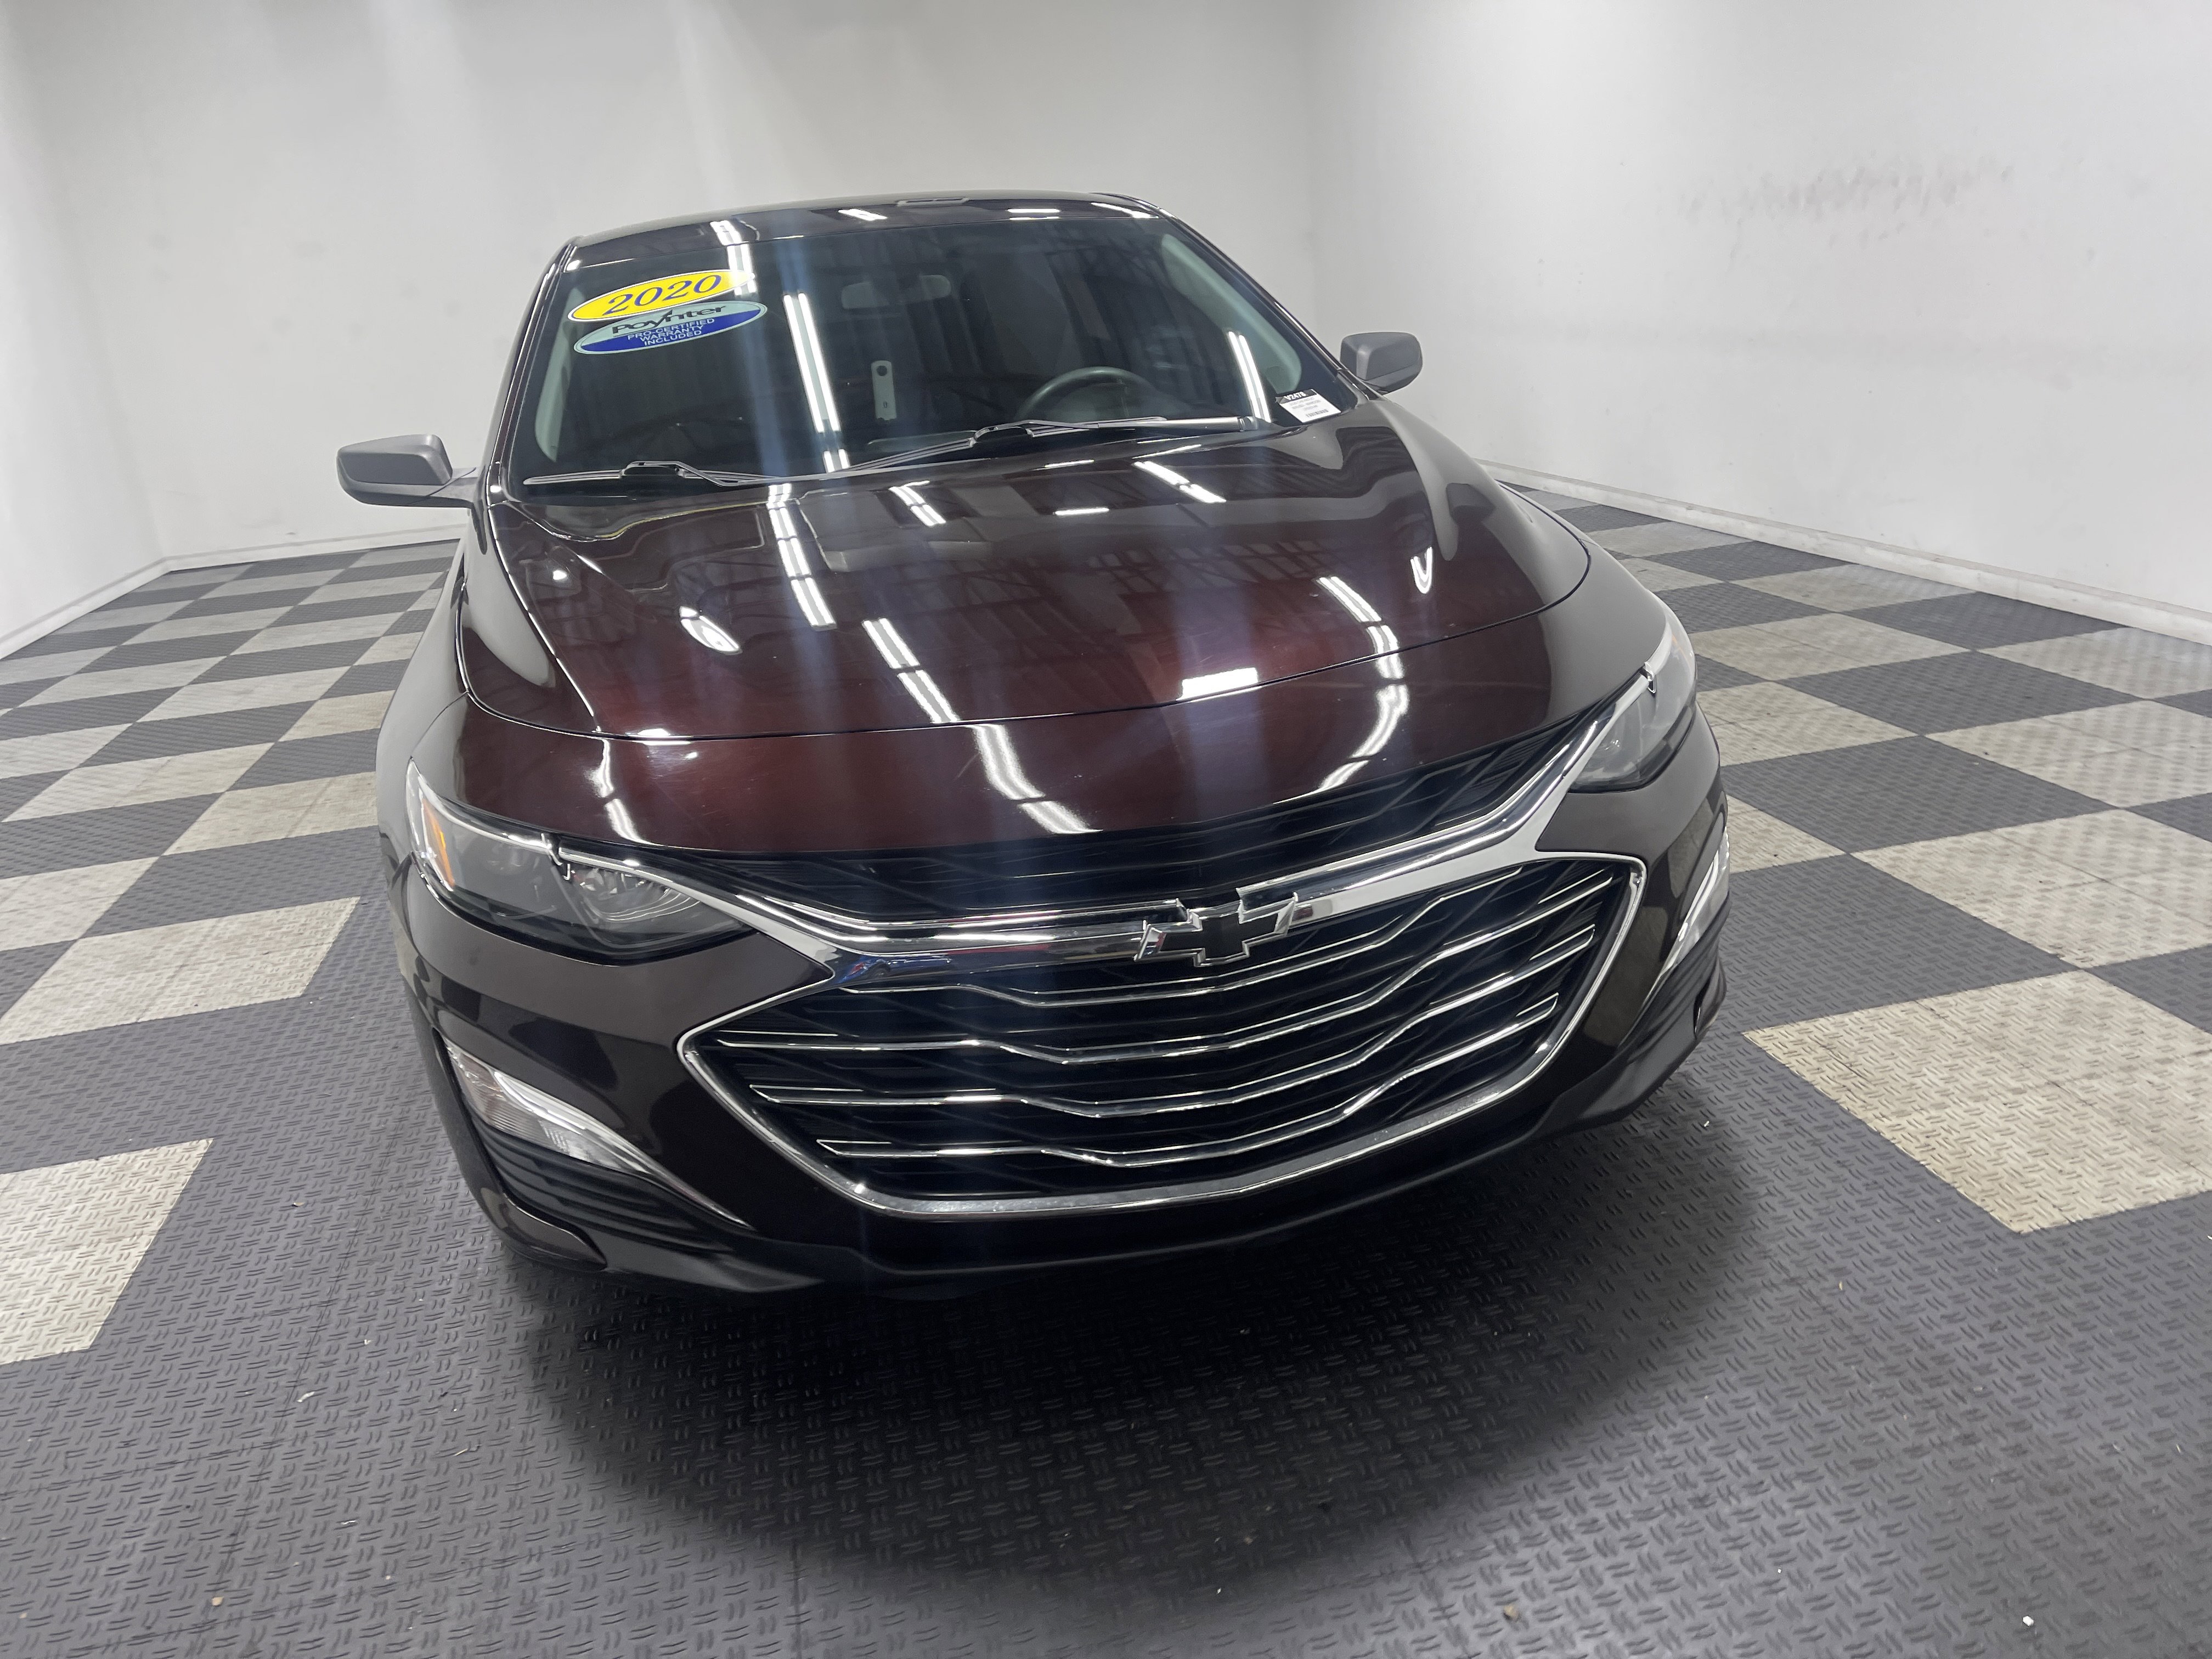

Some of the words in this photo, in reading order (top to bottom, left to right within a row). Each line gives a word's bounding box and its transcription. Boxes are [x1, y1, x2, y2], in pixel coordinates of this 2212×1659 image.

[602, 275, 722, 316] 2020
[612, 309, 726, 334] Poynter
[627, 318, 715, 340] PRO-CERTIFIED
[640, 325, 703, 342] WARRANTY
[644, 330, 702, 346] INCLUDED
